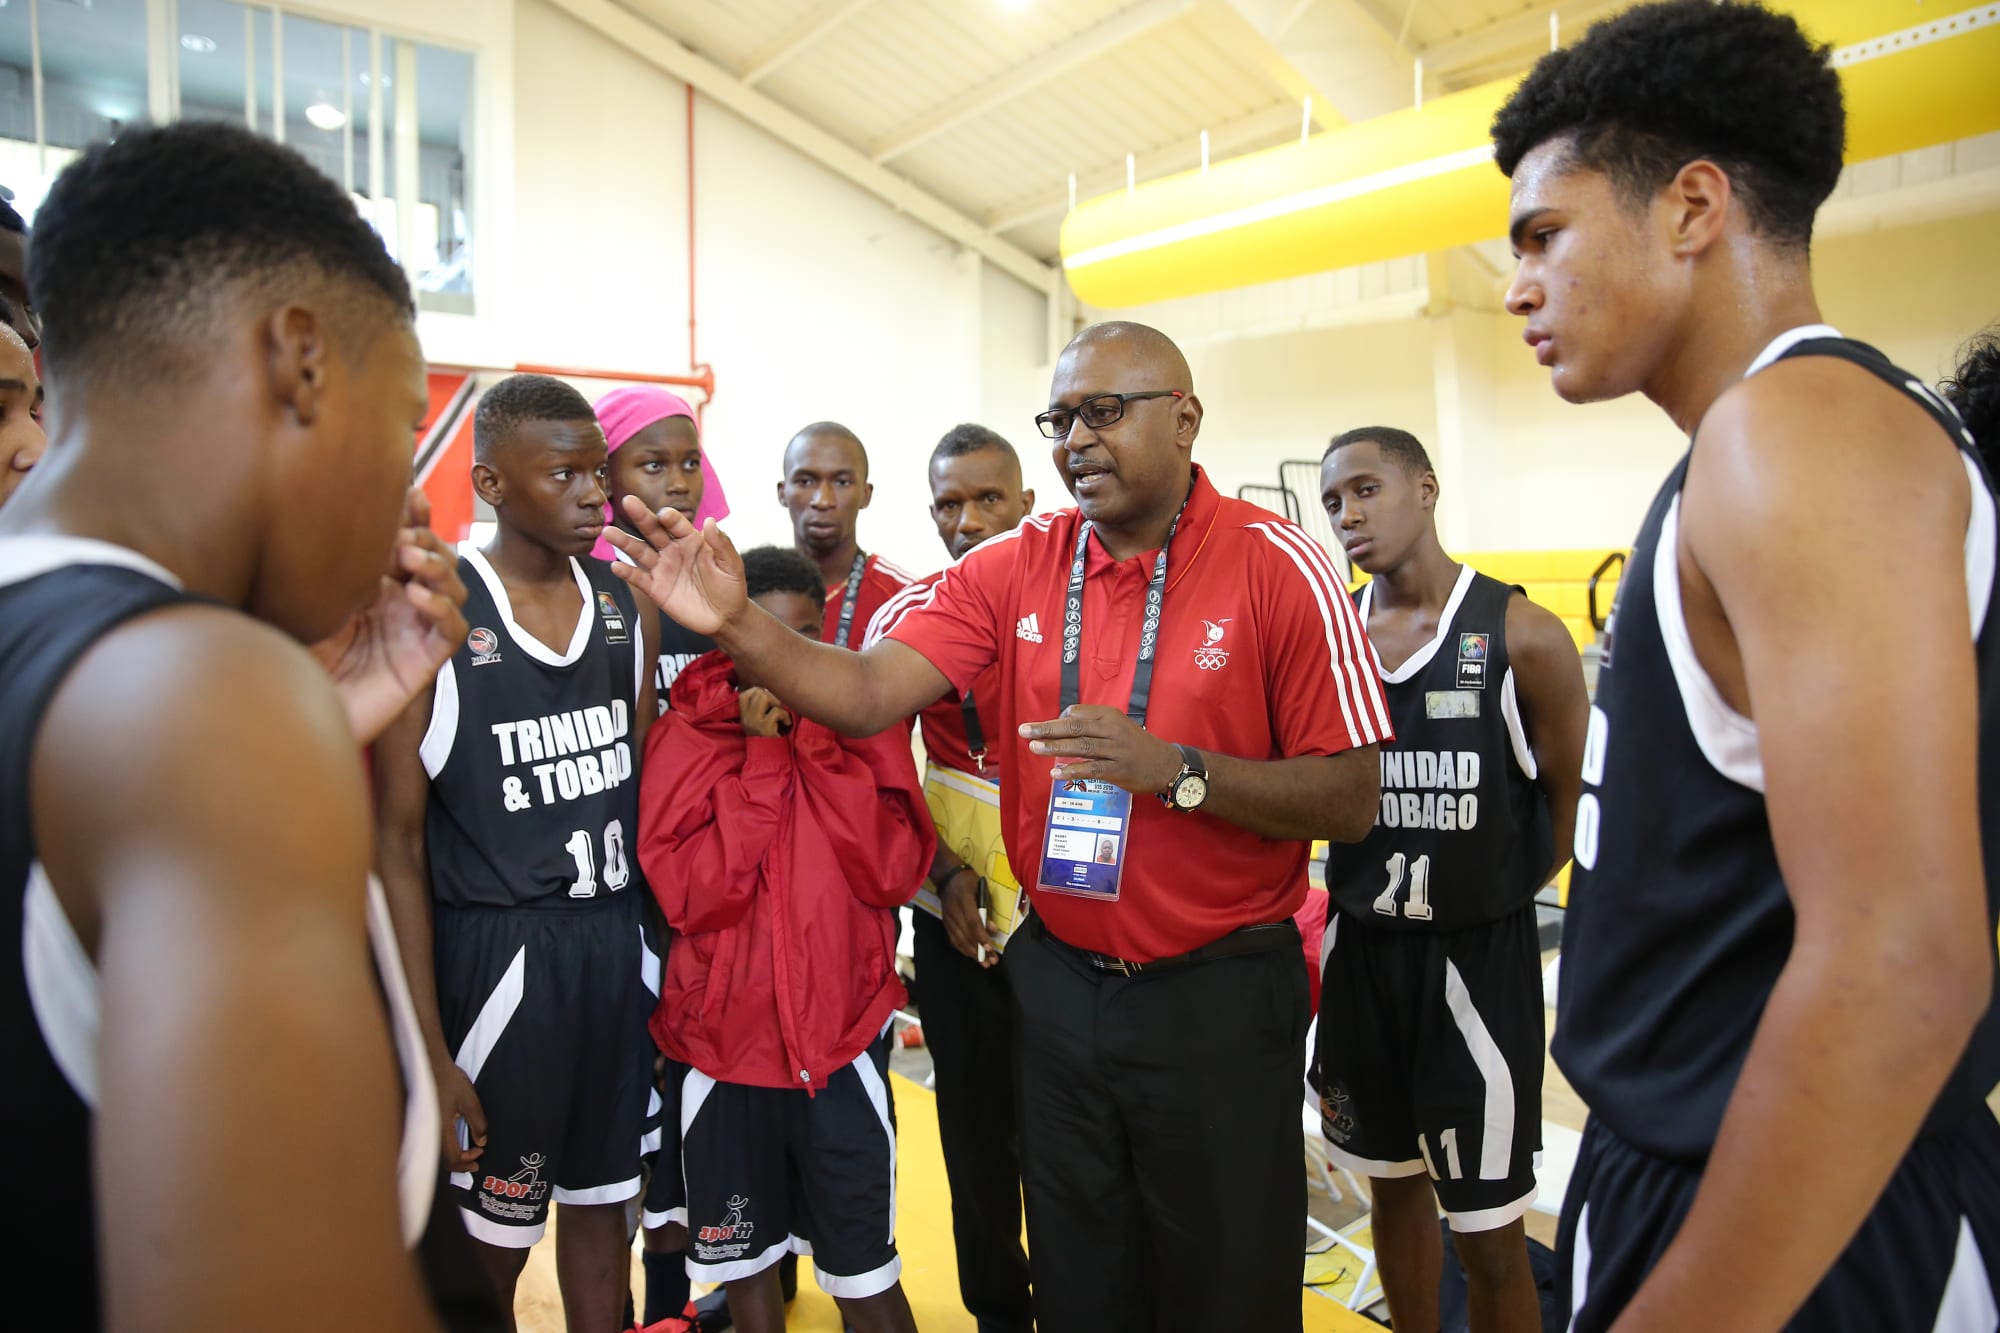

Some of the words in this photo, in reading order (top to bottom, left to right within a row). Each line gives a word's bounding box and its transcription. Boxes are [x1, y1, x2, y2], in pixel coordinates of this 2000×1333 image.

[1461, 663, 1482, 675] FIBA
[491, 699, 628, 766] TRINIDD
[502, 776, 531, 812] &
[532, 742, 632, 805] TOBAO
[1379, 751, 1480, 789] NIDAD
[1373, 792, 1478, 831] OBAGO
[565, 819, 630, 898] 10
[1373, 852, 1433, 921] 11
